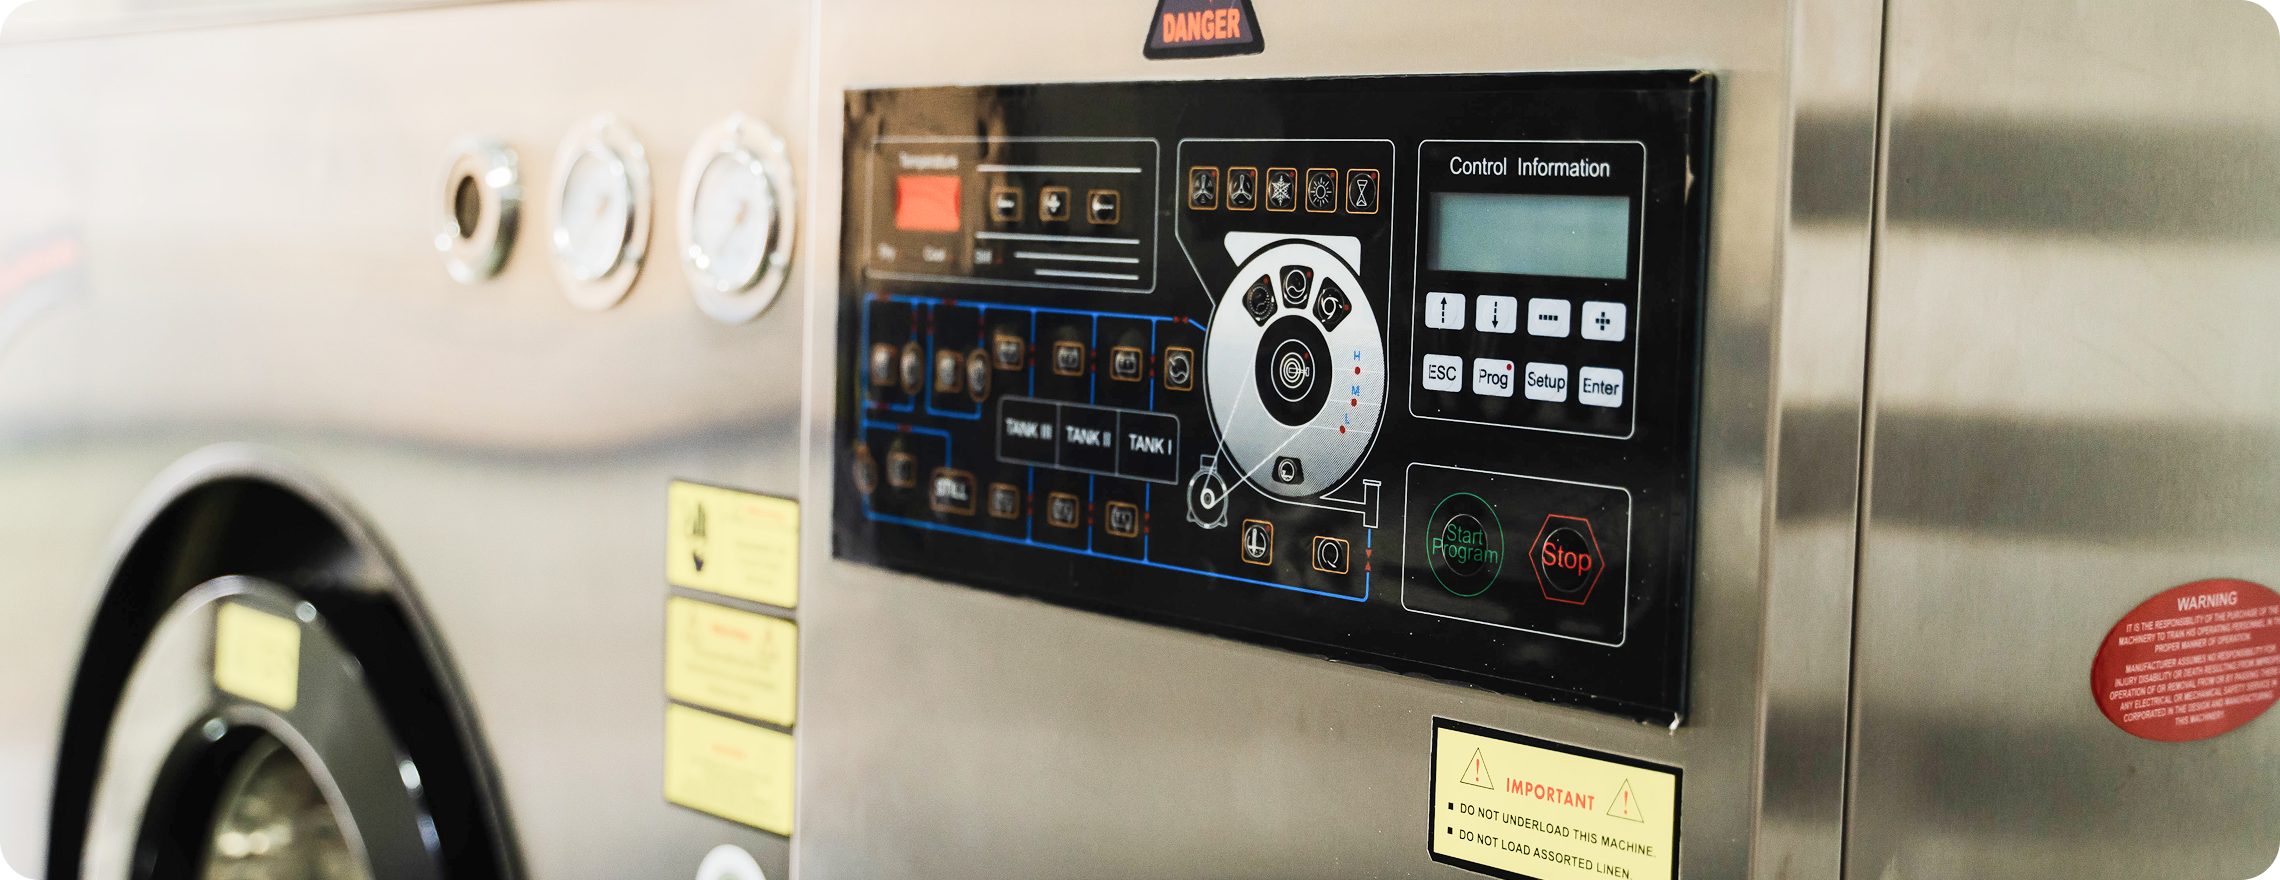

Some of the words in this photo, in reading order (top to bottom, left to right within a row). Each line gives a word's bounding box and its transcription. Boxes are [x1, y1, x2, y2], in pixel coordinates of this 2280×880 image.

[1163, 8, 1241, 43] DANGER
[1450, 156, 1507, 176] Control
[1518, 157, 1610, 177] Information
[1354, 350, 1360, 361] H
[1428, 364, 1457, 381] ESC
[1479, 368, 1508, 389] Prog
[1527, 372, 1565, 392] Setup
[1351, 385, 1360, 396] M
[1583, 377, 1619, 396] Enter
[1005, 417, 1038, 439] TANK
[1040, 423, 1053, 440] III
[1066, 425, 1099, 447] TANK
[1103, 431, 1111, 448] II
[1128, 433, 1164, 455] TANK
[1168, 439, 1172, 456] I
[1447, 523, 1483, 545] Start
[1432, 537, 1498, 564] Program
[1542, 541, 1592, 576] Stop
[2177, 590, 2238, 611] WARNING
[2126, 623, 2133, 633] IT
[2133, 622, 2140, 632] IS
[2141, 620, 2154, 631] THE
[2155, 614, 2205, 629] RESPONSIBILITY
[2118, 633, 2156, 646] MACHINERY
[2157, 632, 2166, 641] TO
[2167, 629, 2185, 640] TRAIN
[2154, 641, 2180, 653] PROPER
[2181, 637, 2206, 649] MANNER
[2126, 658, 2177, 673] MANUFACTURER
[2109, 687, 2146, 701] OPERATION
[2147, 685, 2156, 695] OF
[2157, 683, 2166, 694] OR
[2120, 701, 2134, 711] ANY
[2135, 696, 2173, 709] ELECTRICAL
[2124, 707, 2166, 722] CORPORATED
[1506, 777, 1595, 811] IMPORTANT
[1460, 803, 1475, 815] DO
[1478, 807, 1499, 821] NOT
[1502, 812, 1570, 838] UNDERLOAD
[1573, 828, 1597, 844] THIS
[1601, 835, 1656, 858] MACHINE.
[1459, 829, 1474, 842] DO
[1477, 833, 1498, 848] NOT
[1501, 839, 1531, 856] LOAD
[1533, 847, 1593, 870] ASSORTED
